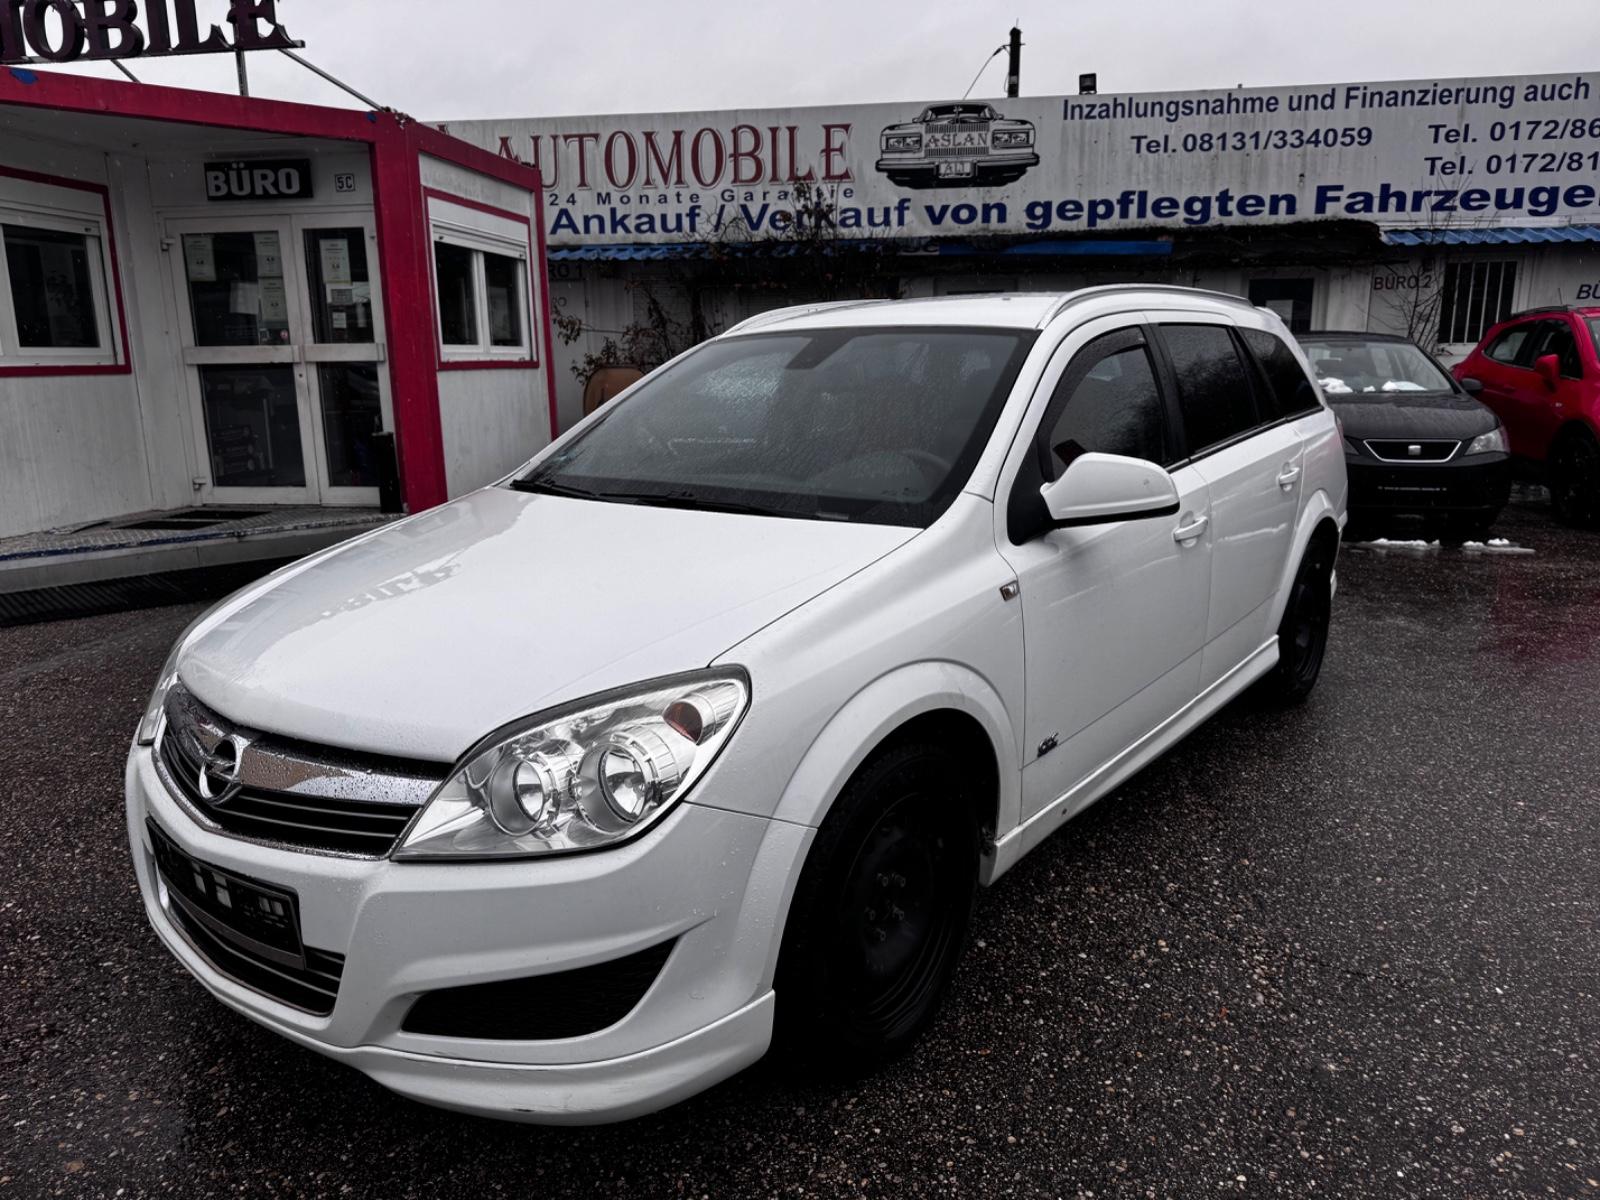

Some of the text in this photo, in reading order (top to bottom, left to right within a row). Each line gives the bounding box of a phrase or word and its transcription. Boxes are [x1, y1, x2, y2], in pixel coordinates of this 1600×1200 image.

[1062, 76, 1590, 122] Inzahlungsnahme und Finanzierung auch
[925, 132, 989, 149] ASLAN
[1428, 123, 1478, 145] Tel.
[1423, 155, 1474, 177] Tel.
[206, 161, 301, 197] BÜRO
[549, 192, 577, 206] 24
[596, 190, 701, 206] Monate
[549, 204, 702, 235] Ankauf
[924, 202, 1008, 226] von
[1024, 187, 1298, 231] gepflegten
[1313, 183, 1600, 218] Fahrzeuge
